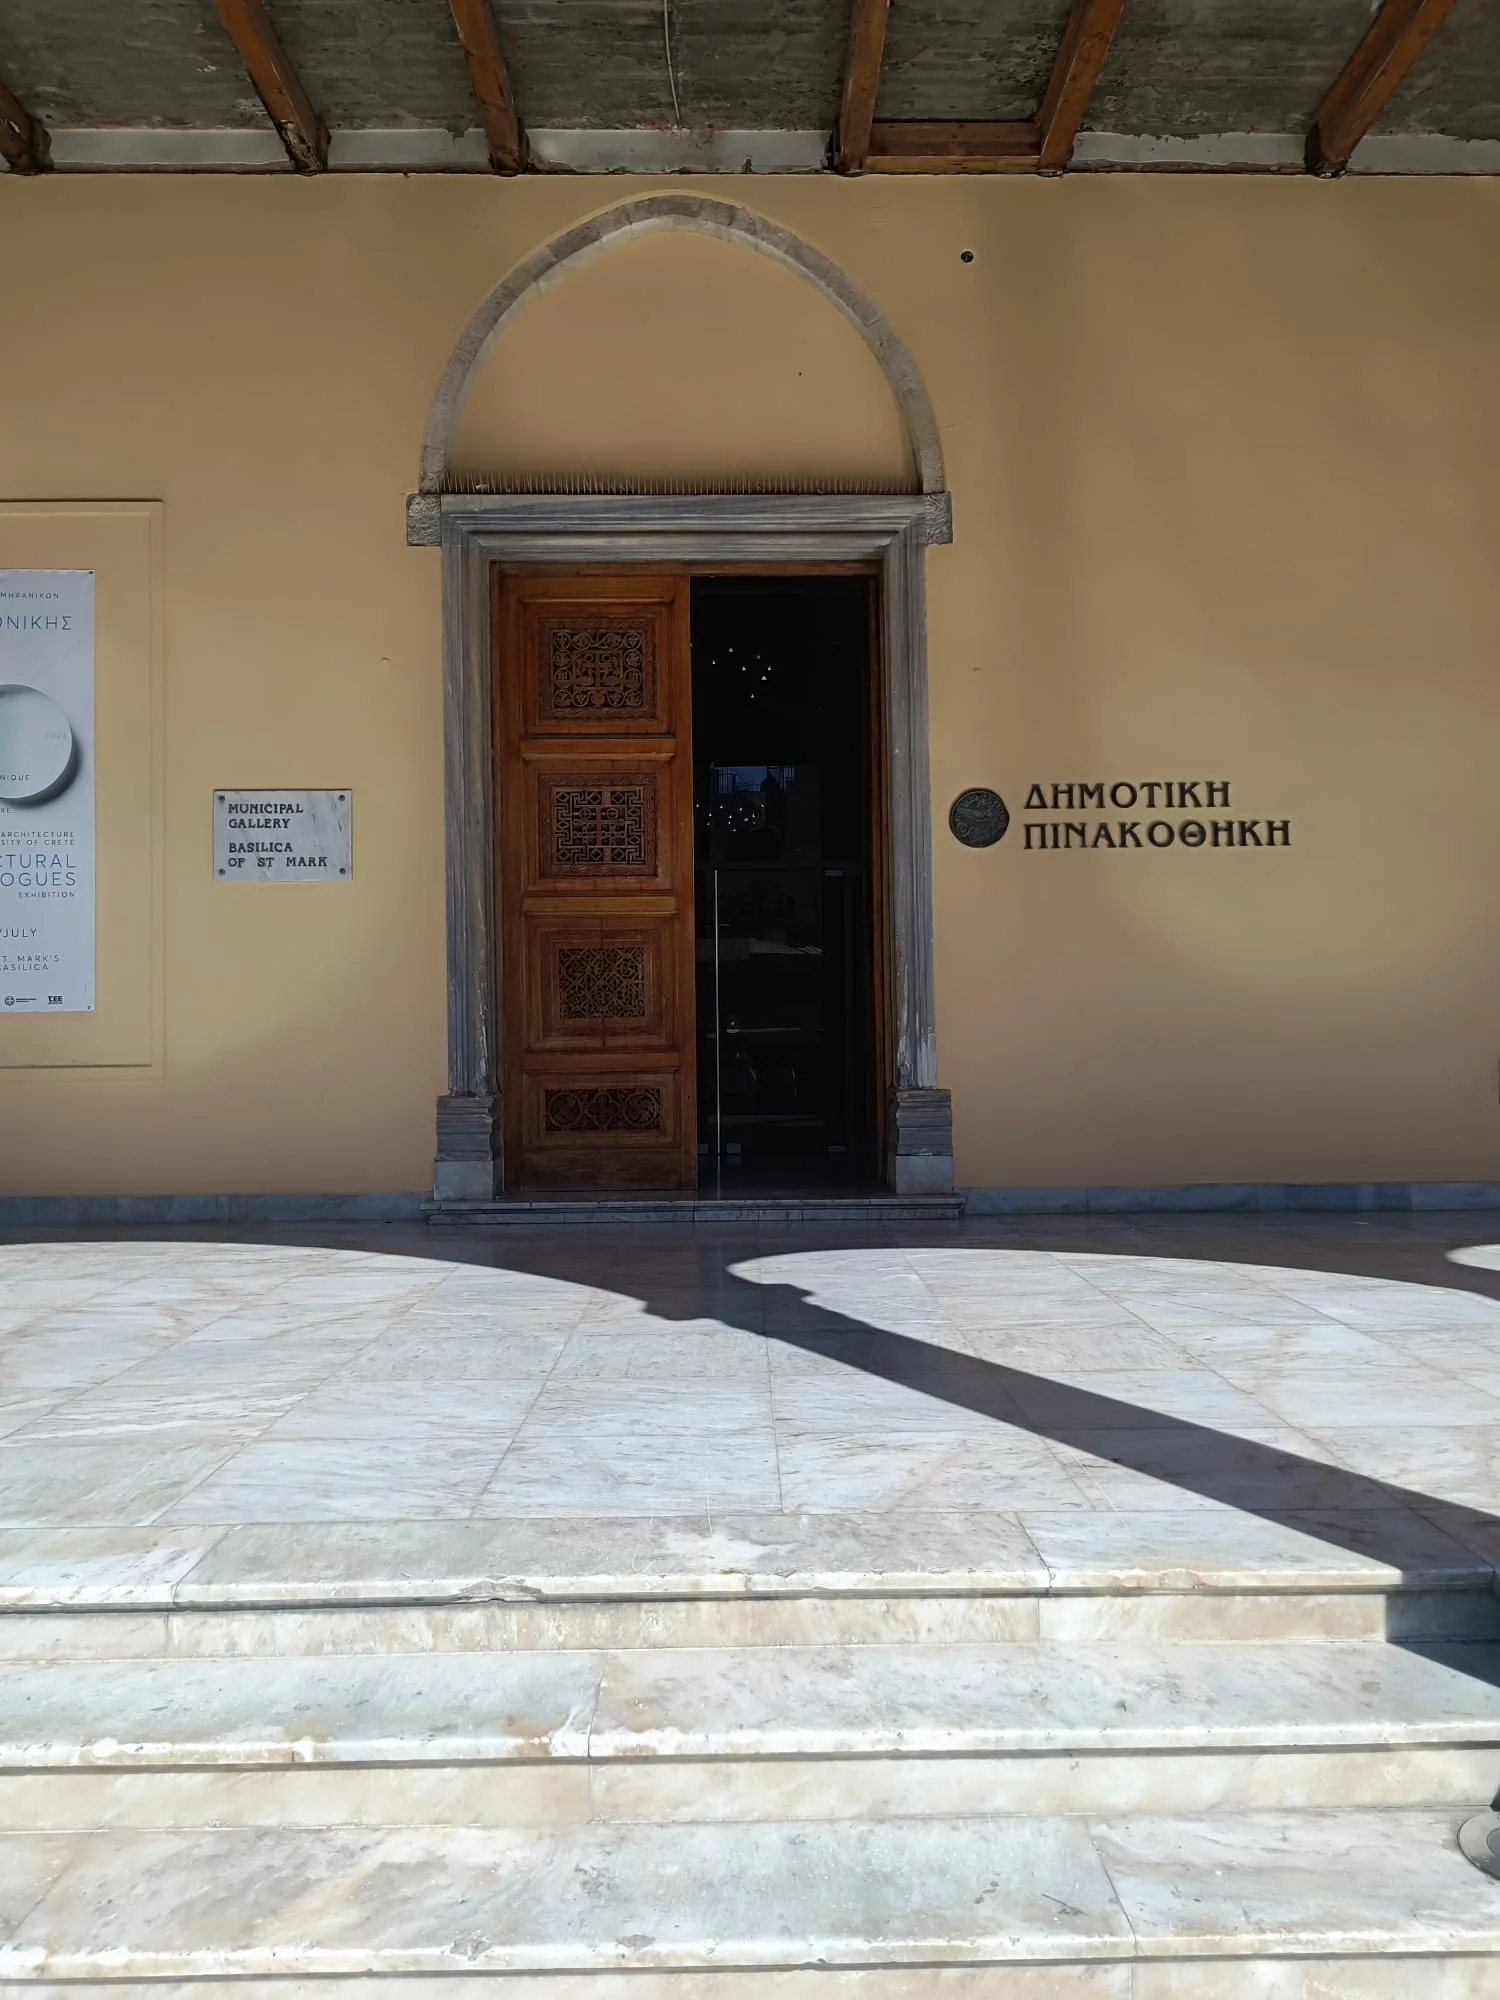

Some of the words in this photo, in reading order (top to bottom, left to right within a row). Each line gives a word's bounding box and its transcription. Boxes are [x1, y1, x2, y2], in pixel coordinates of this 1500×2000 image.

[0, 615, 73, 630] ΝΙΚΗΣ
[1023, 780, 1232, 810] ΔΗΜΟΤΙΚΗ
[228, 803, 304, 814] MUNICIPAL
[228, 818, 291, 829] GALLERY
[1023, 819, 1292, 850] ΠΙΝΑΚΟΘΗΚΗ
[228, 842, 293, 853] BASILICA
[0, 853, 76, 869] TURAL
[228, 857, 246, 868] OF
[257, 857, 275, 868] ST
[286, 856, 328, 867] MARK
[0, 872, 76, 887] OGUES
[18, 891, 75, 899] EXHIBITION
[0, 963, 49, 971] ASILICA
